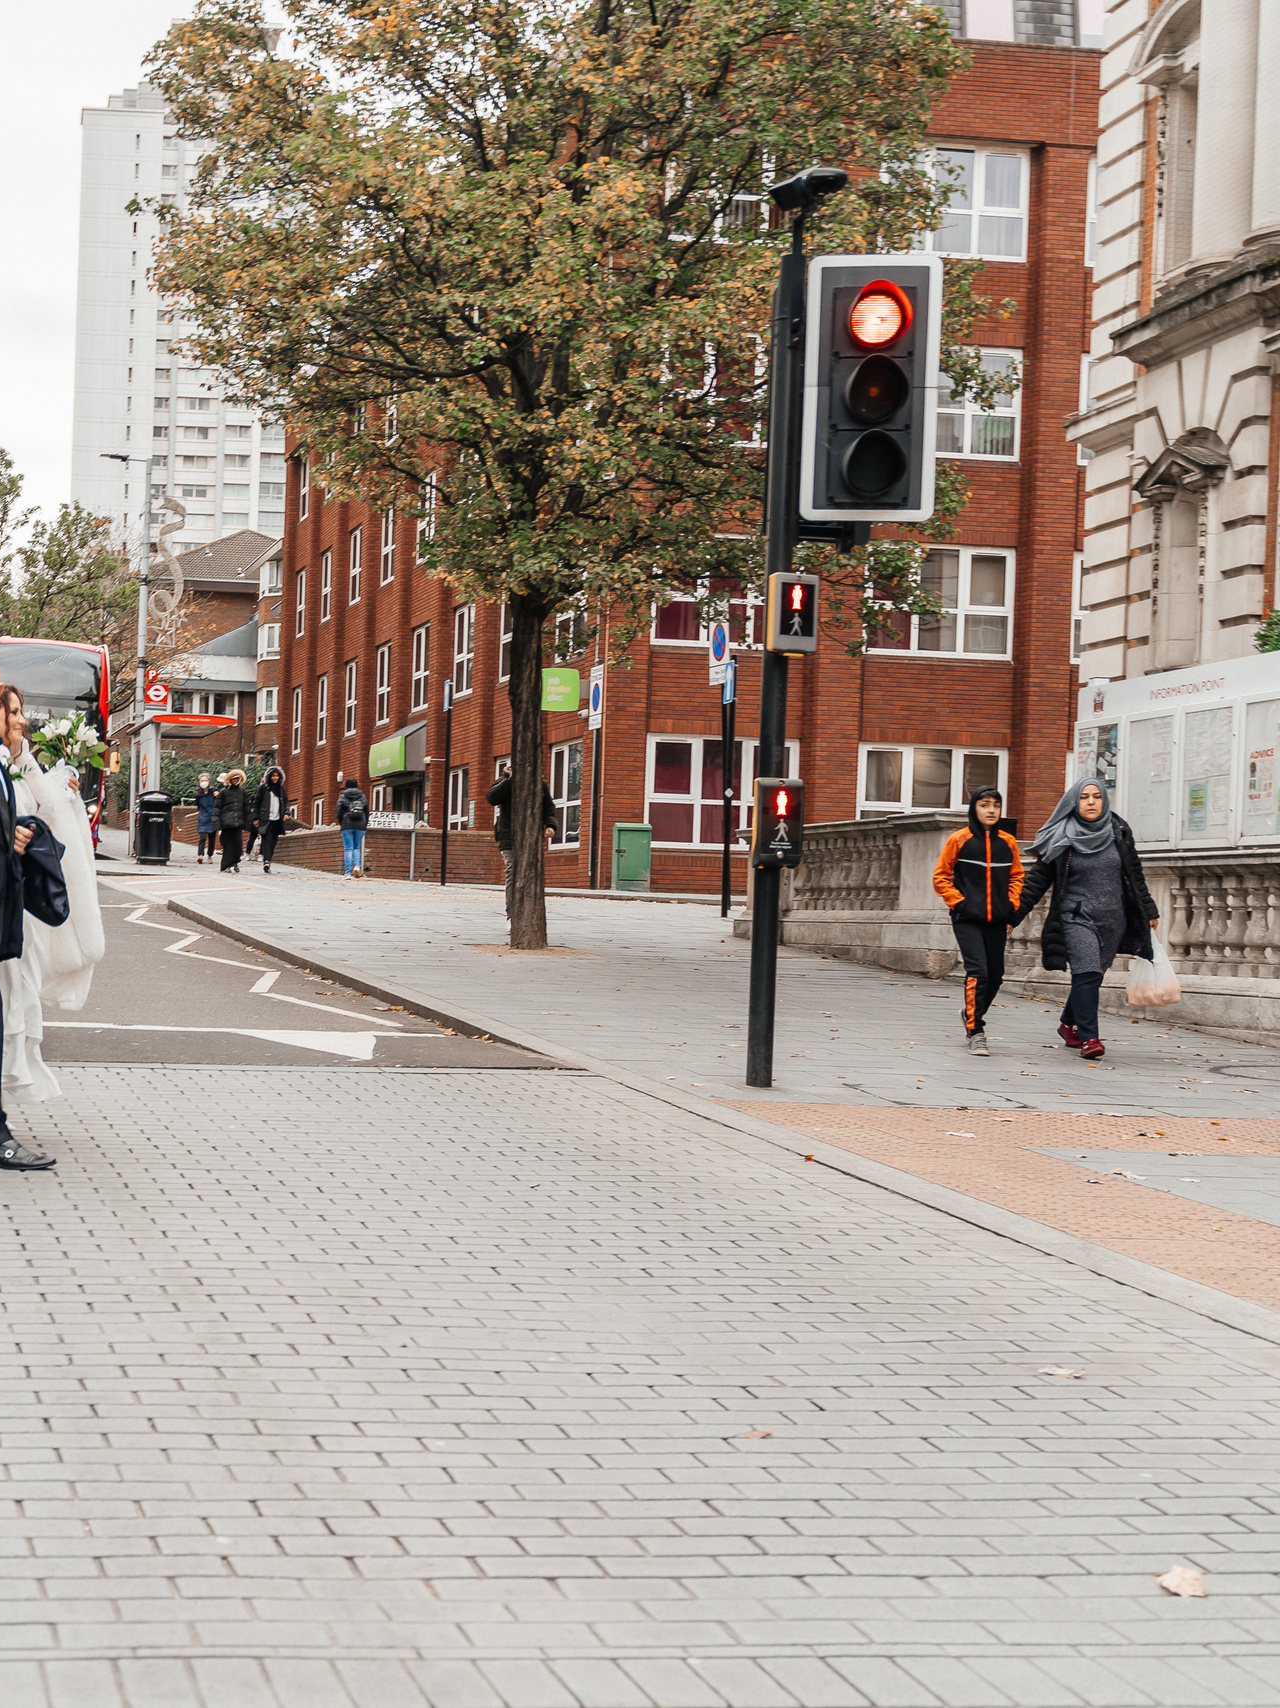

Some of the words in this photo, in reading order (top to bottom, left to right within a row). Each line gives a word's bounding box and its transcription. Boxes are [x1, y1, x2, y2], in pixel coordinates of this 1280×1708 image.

[148, 669, 157, 680] P
[1150, 684, 1200, 700] INFORMATION
[1201, 677, 1225, 692] POINT
[367, 820, 398, 828] STREET
